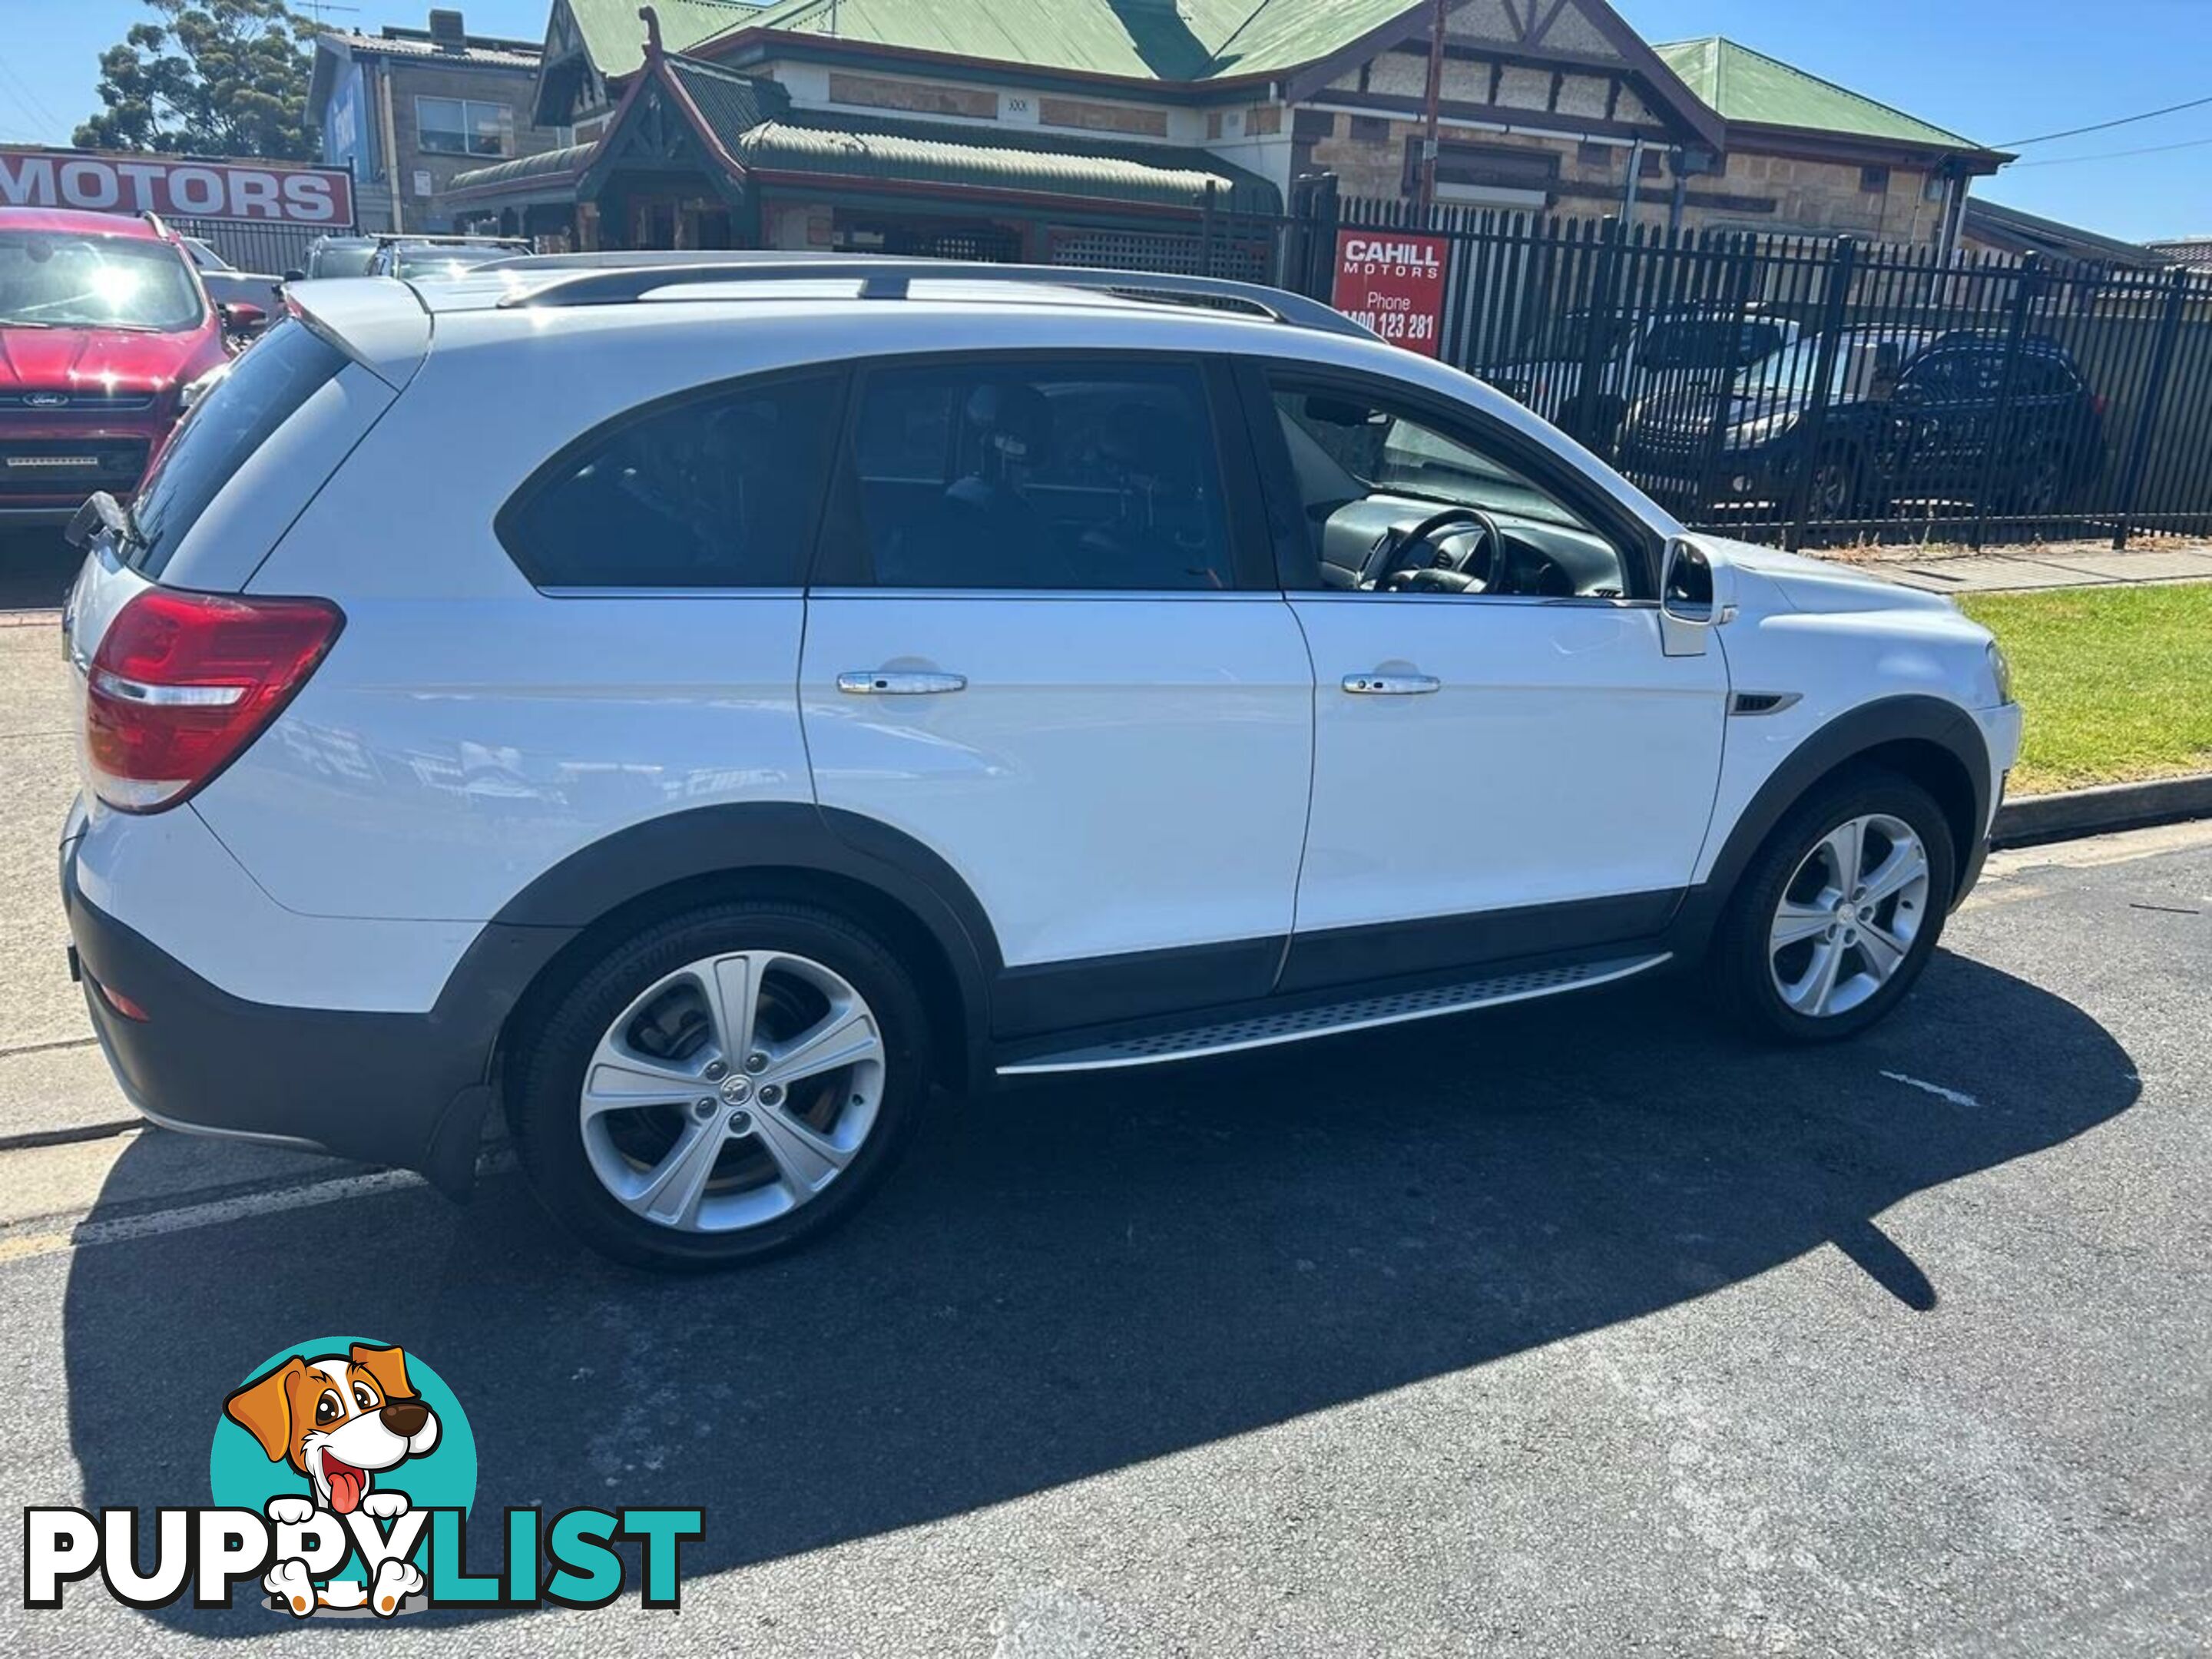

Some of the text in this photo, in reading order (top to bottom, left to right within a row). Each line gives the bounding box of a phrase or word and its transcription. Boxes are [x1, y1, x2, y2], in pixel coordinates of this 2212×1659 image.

[0, 158, 335, 220] MOTORS
[1346, 240, 1439, 267] CAHILL
[1344, 262, 1438, 279] MOTORS
[1366, 292, 1411, 310] Phone
[1379, 312, 1405, 338] 123
[1408, 314, 1433, 339] 281
